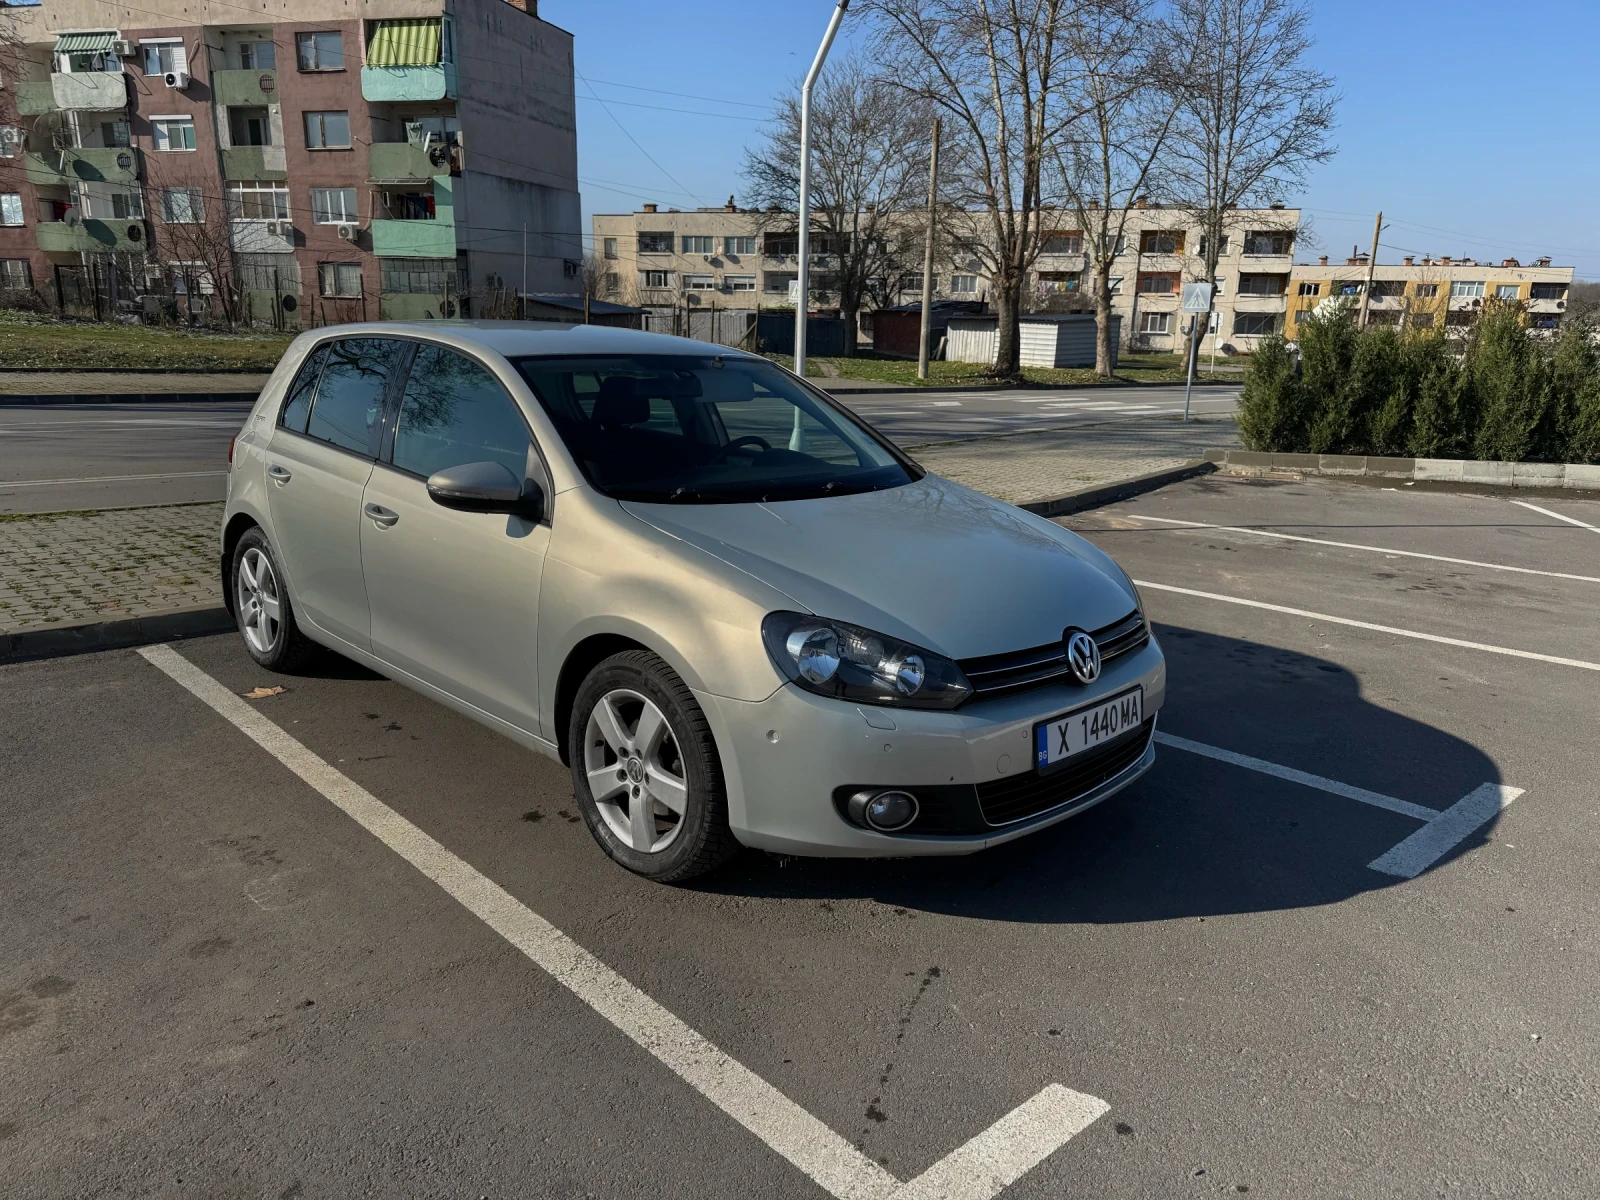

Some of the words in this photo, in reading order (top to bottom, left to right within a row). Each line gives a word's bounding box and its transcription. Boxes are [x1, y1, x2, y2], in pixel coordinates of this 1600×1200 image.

[1068, 632, 1101, 684] VW
[1057, 722, 1070, 755] X
[1082, 704, 1118, 745] 1440
[1120, 695, 1139, 728] MA
[1038, 751, 1048, 761] BG
